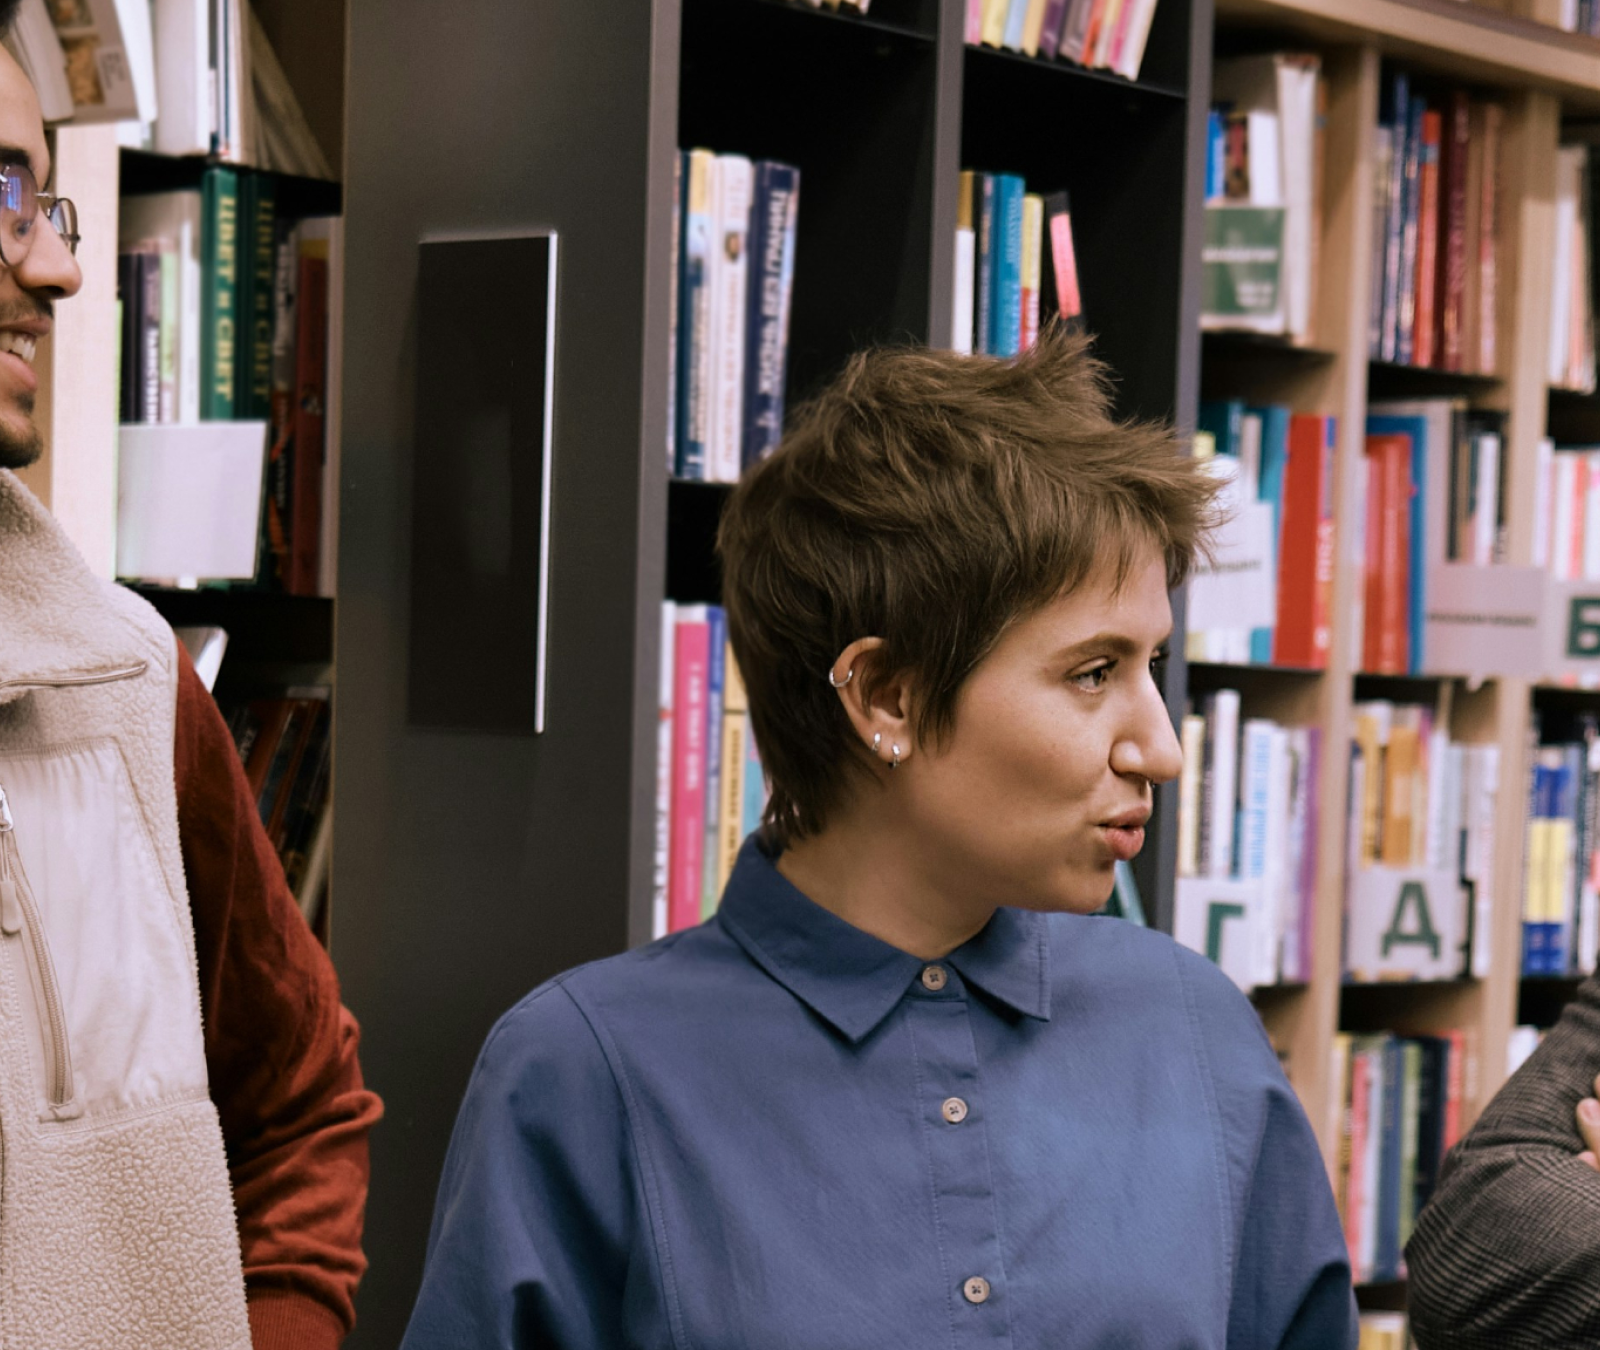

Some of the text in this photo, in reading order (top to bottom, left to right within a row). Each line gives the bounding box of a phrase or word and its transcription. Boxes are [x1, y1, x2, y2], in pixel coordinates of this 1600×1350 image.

[218, 195, 236, 283] ЦВЕТ
[758, 189, 789, 396] ЖИЗНЬ БЕЗ ГРАНИЦ
[146, 328, 159, 423] ТАИНСТВЕНН
[215, 316, 234, 402] СВЕТ
[1203, 902, 1245, 967] Г
[1380, 881, 1442, 959] Д
